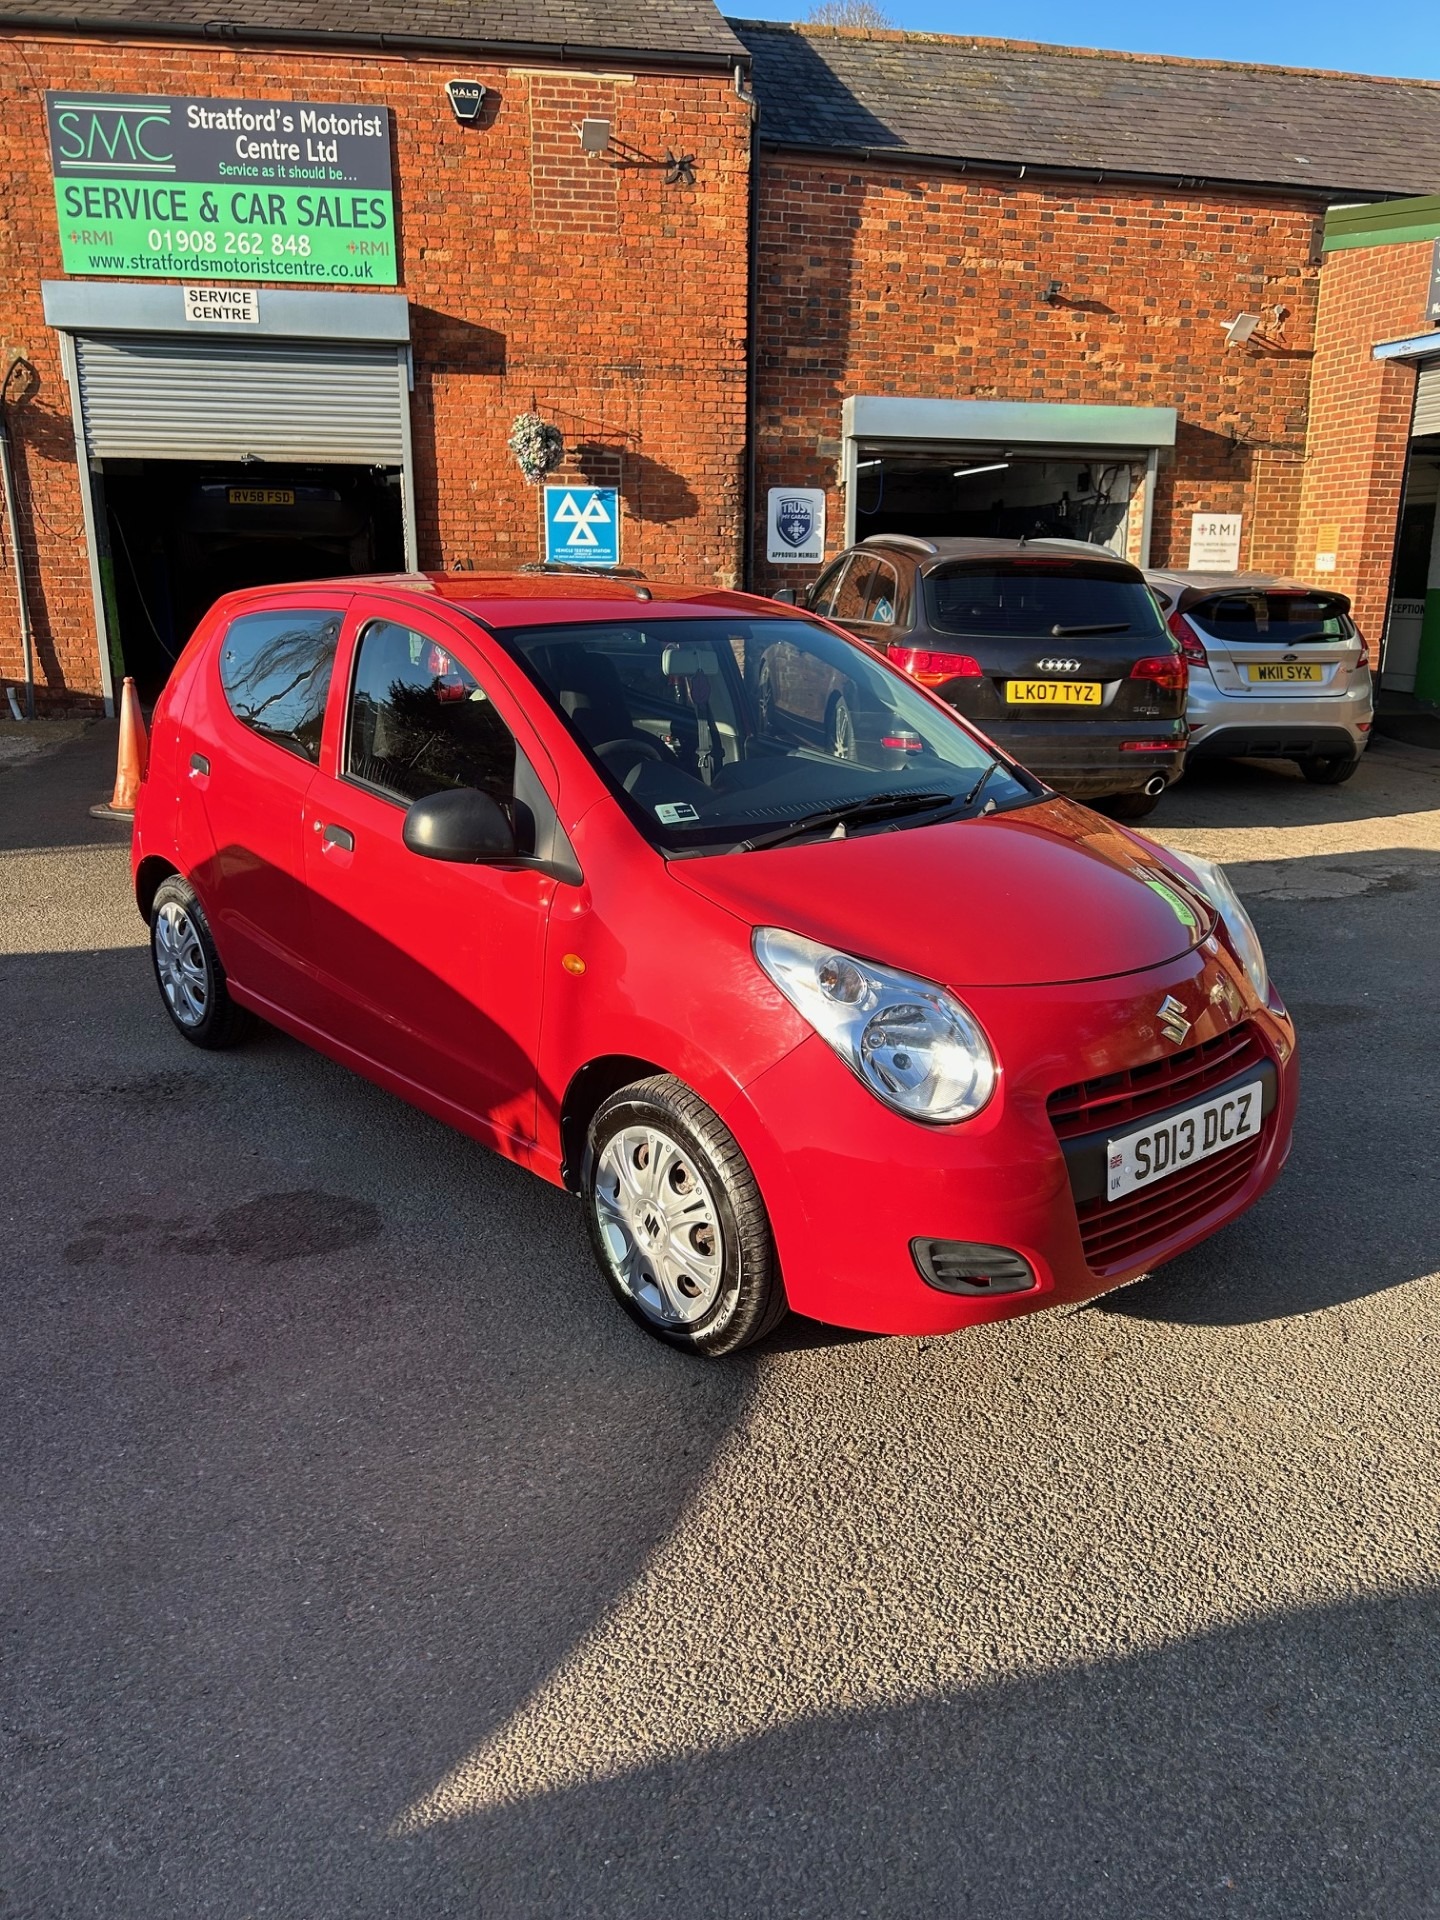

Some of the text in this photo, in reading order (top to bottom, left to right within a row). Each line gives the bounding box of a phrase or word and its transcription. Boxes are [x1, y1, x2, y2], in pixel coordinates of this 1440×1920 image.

[187, 104, 382, 137] Stratford's Motorist
[58, 112, 174, 162] SMC
[235, 136, 338, 163] Centre Ltd
[219, 162, 258, 177] Service
[262, 167, 275, 178] as
[277, 165, 286, 179] it
[288, 165, 326, 180] should
[65, 186, 387, 230] SERVICE & CAR SALES
[148, 229, 312, 257] 01908 262 848
[89, 253, 373, 279] www.stratfordsmotoristcentre.co.uk
[189, 289, 251, 304] SERVICE
[192, 306, 251, 320] CENTRE
[234, 491, 290, 503] RV58 FSD
[1258, 666, 1312, 680] WK11 SYX
[1015, 684, 1094, 701] LK07 TYZ
[1134, 1092, 1252, 1181] SD13 DCZ
[1110, 1175, 1121, 1190] UK
